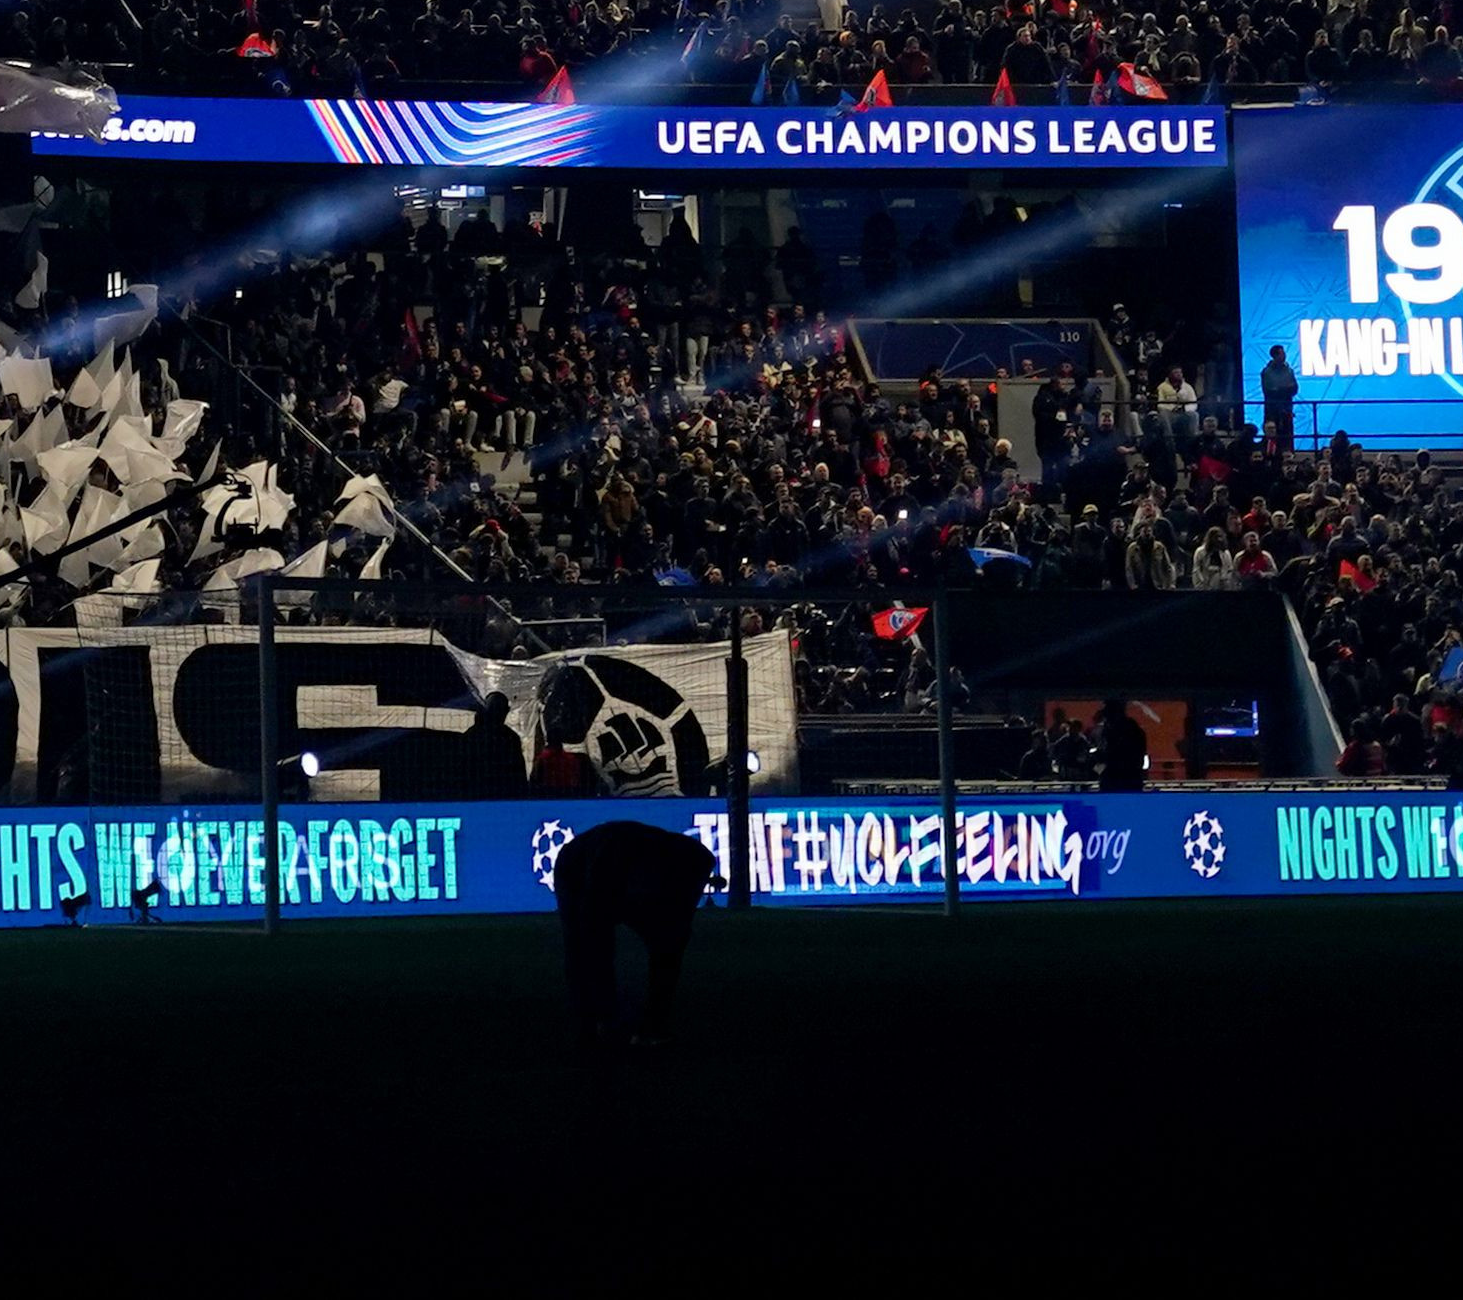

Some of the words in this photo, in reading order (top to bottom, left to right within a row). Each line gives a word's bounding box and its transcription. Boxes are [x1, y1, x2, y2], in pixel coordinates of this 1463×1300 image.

[658, 121, 765, 154] UEFA
[777, 120, 1035, 155] CHAMPIONS
[1049, 119, 1216, 154] LEAGUE
[1059, 331, 1081, 343] 110
[1300, 317, 1445, 376] KANG-IN
[95, 822, 158, 908] WE
[165, 820, 301, 907] NEVER
[307, 818, 461, 905] FORGET
[1277, 805, 1400, 880] NIGHTS
[1402, 806, 1451, 879] WE
